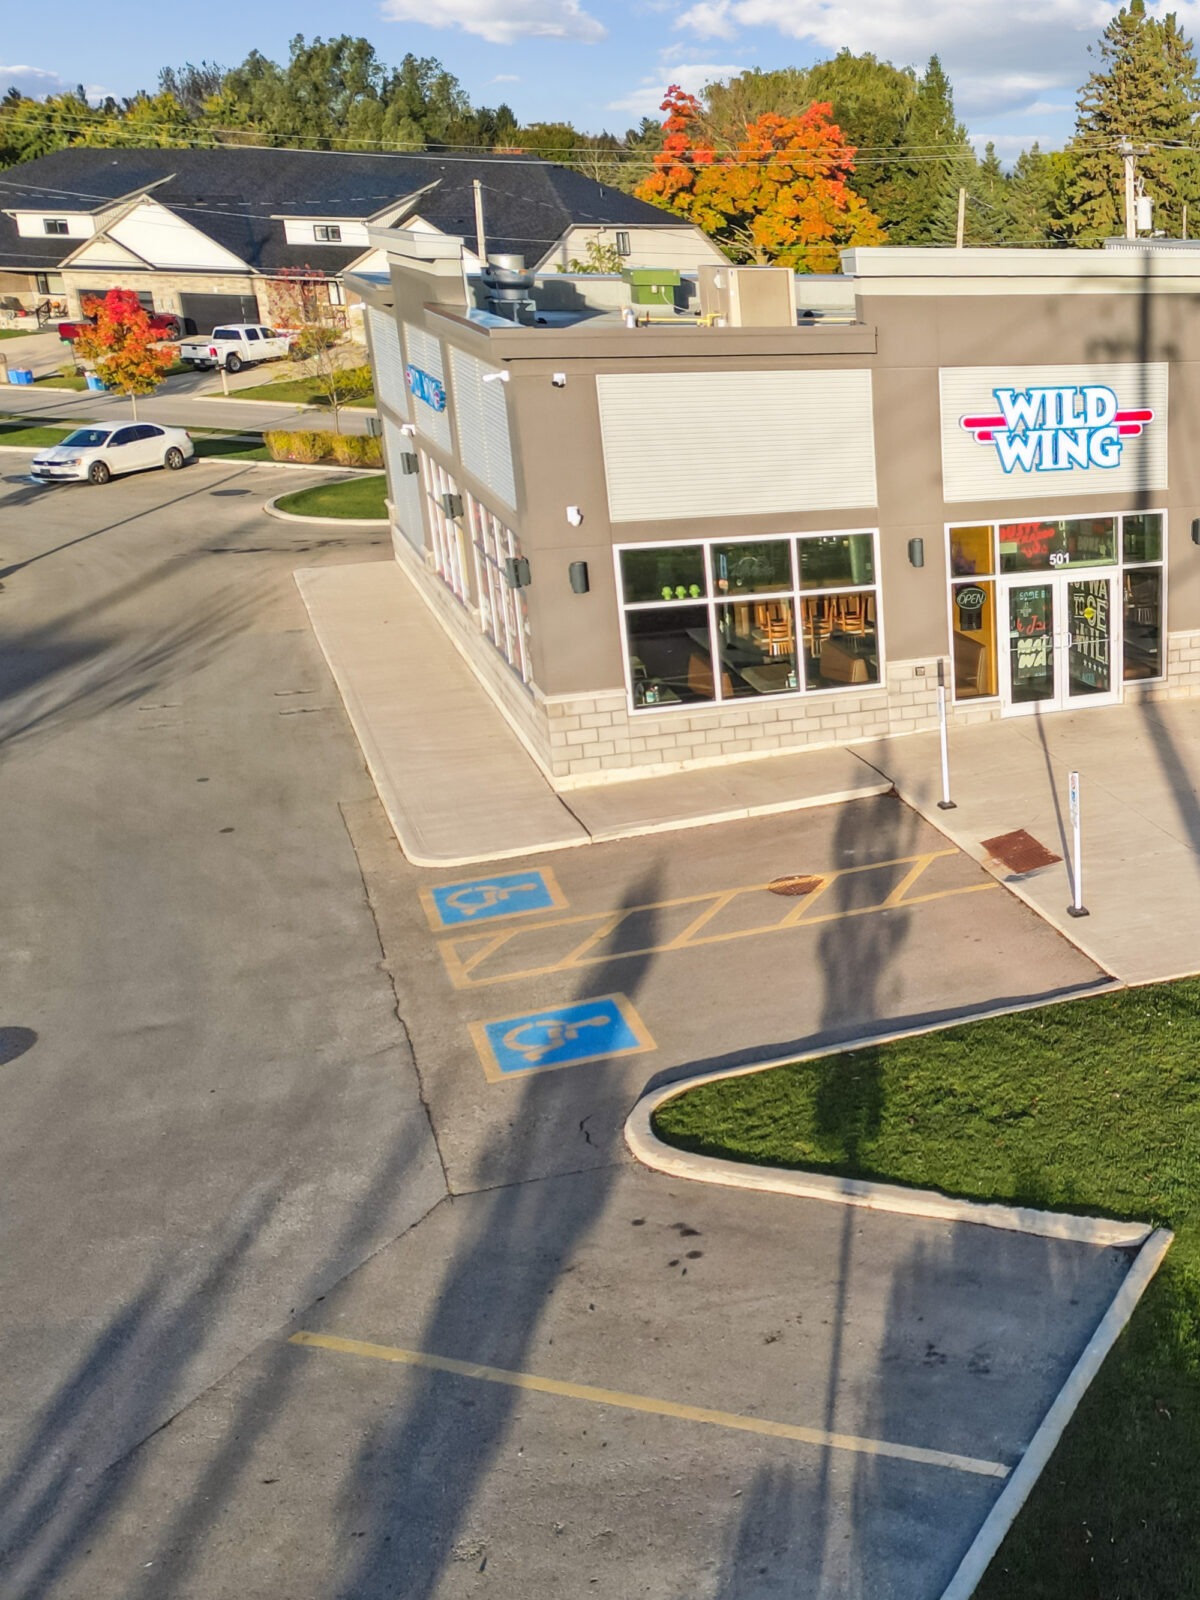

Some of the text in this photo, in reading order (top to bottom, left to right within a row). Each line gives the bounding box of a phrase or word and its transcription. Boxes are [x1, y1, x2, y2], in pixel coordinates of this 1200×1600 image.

[992, 385, 1118, 432] WILD
[992, 427, 1123, 474] WING
[1049, 552, 1070, 566] 501
[958, 592, 985, 605] OPEN
